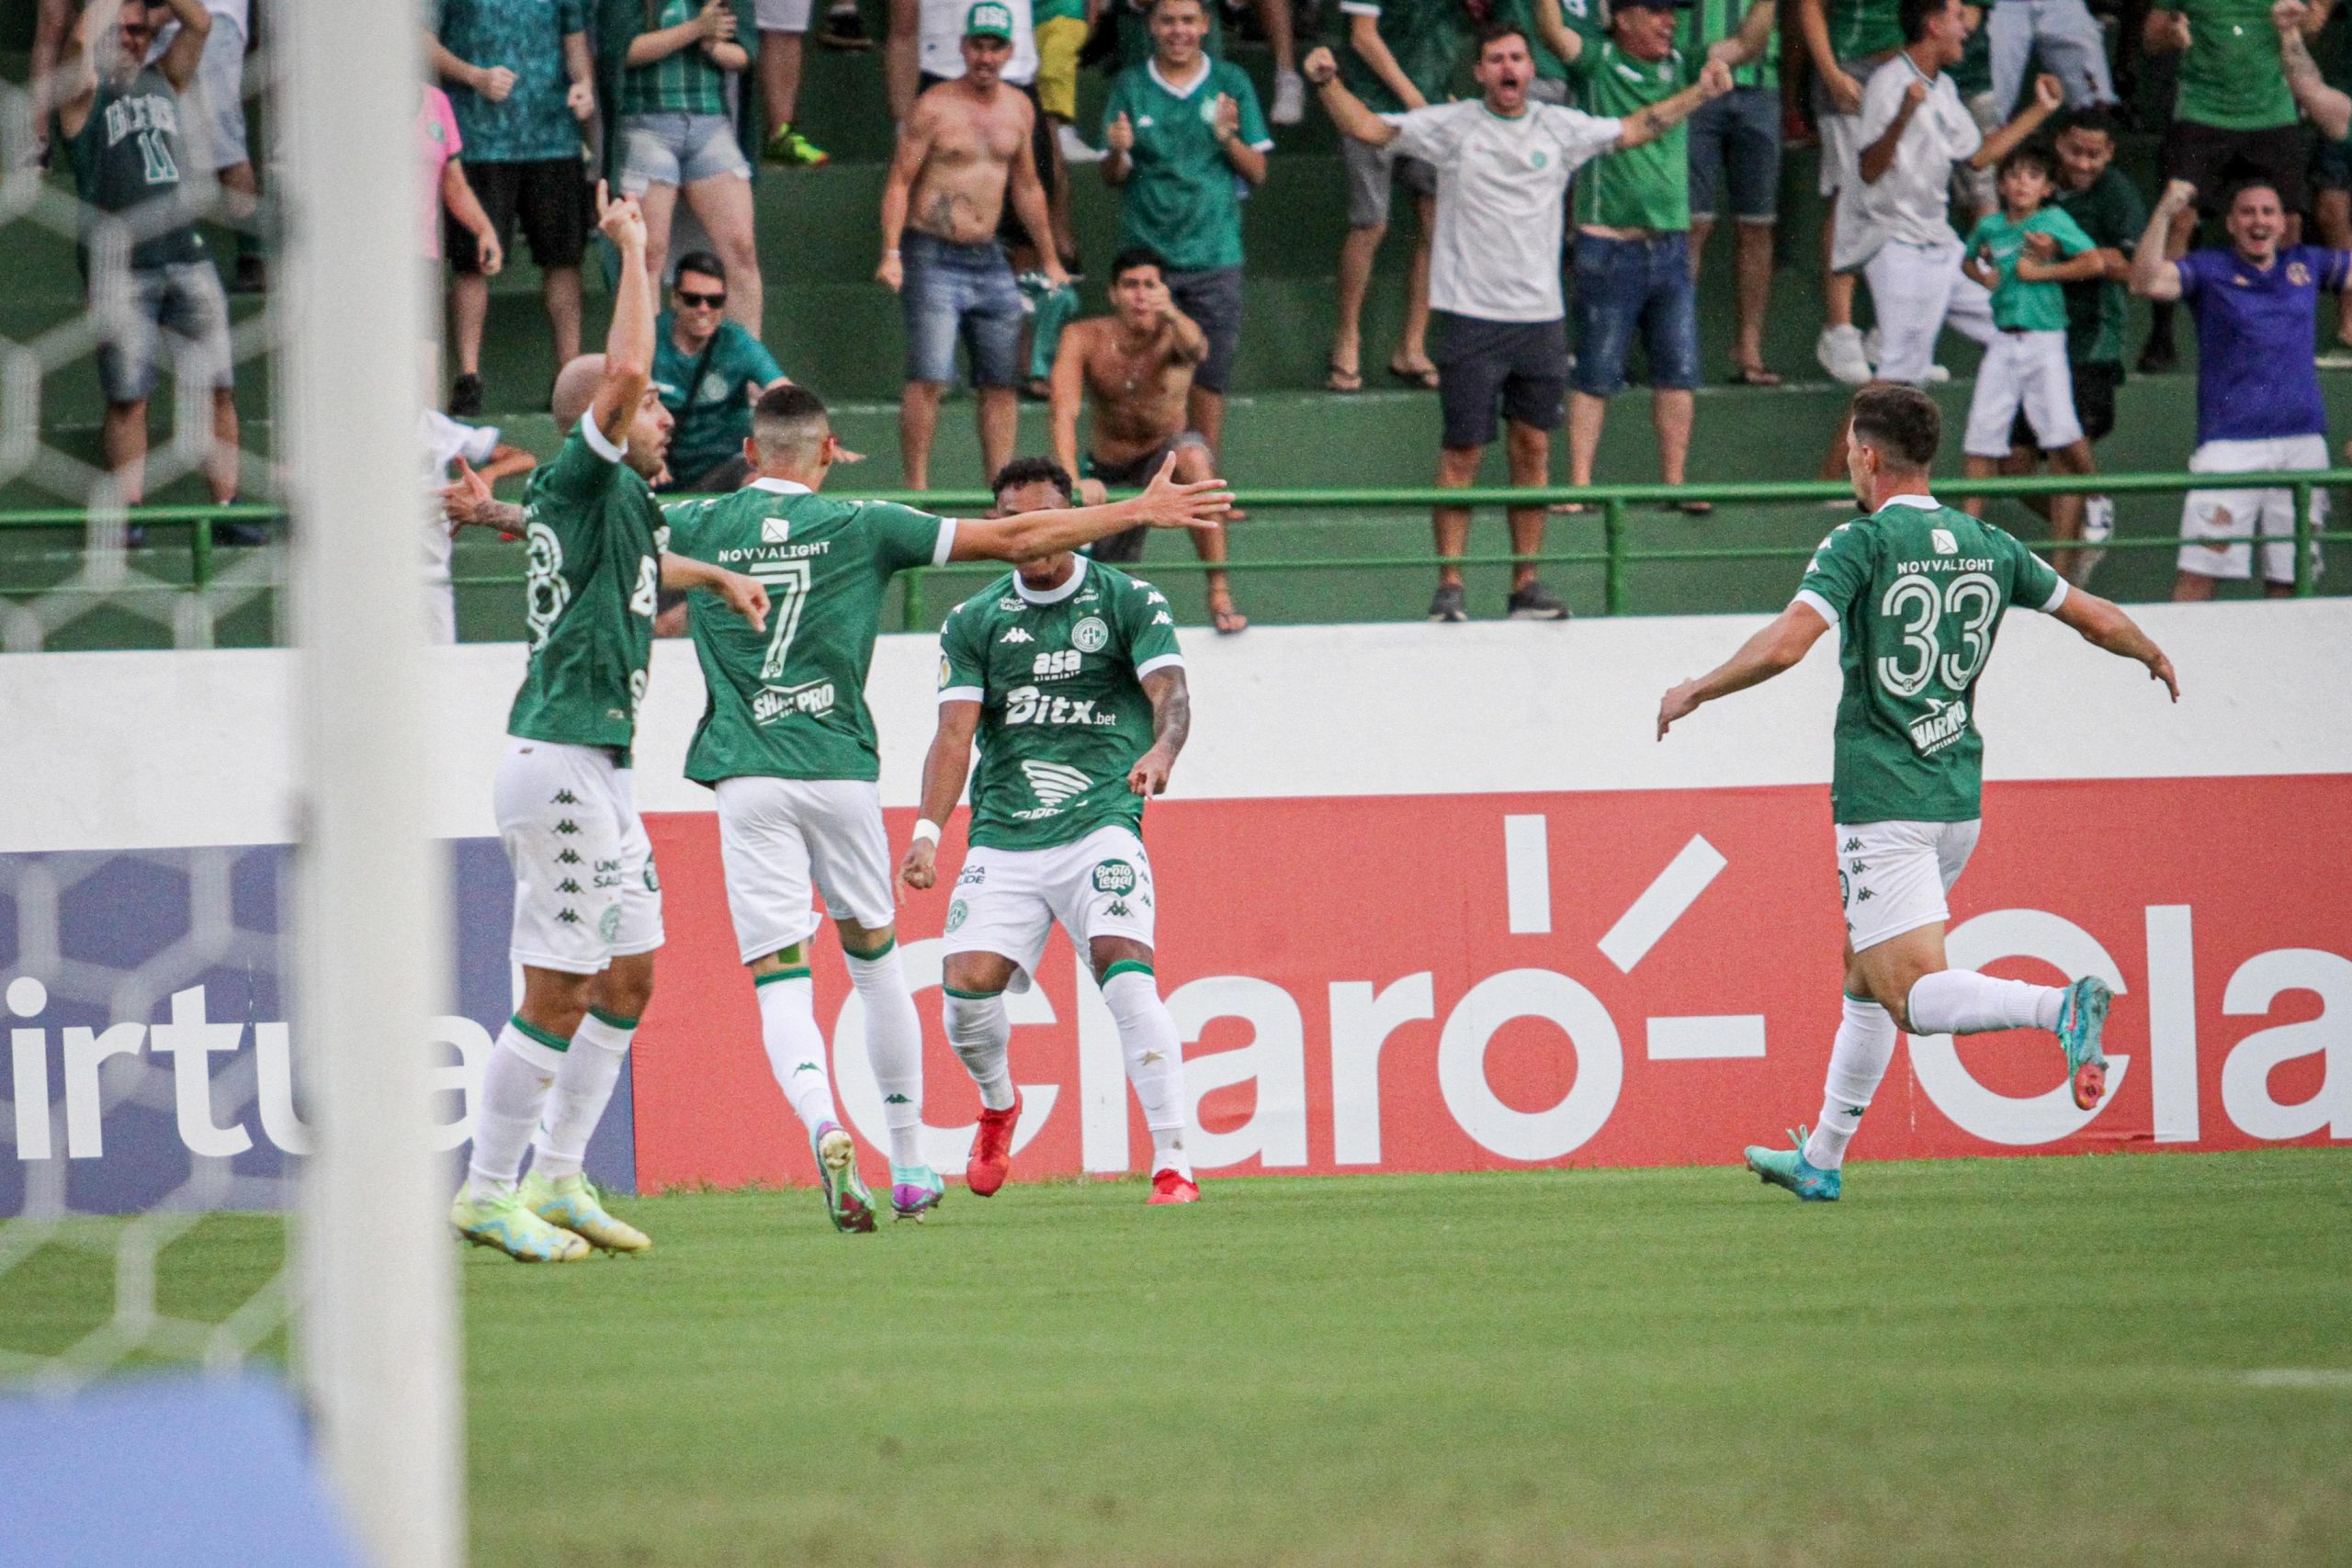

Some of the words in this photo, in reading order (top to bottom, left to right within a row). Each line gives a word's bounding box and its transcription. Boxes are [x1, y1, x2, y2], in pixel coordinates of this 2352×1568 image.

[137, 130, 179, 185] 11
[718, 541, 831, 562] NOVVALIGHT
[1897, 558, 1995, 574] NOVVALIGHT
[750, 559, 811, 679] 7
[1877, 572, 2001, 696] 33
[1033, 649, 1081, 674] asa
[1095, 864, 1131, 878] Broto
[1908, 904, 2352, 1146] Cla
[832, 937, 1623, 1174] Claro
